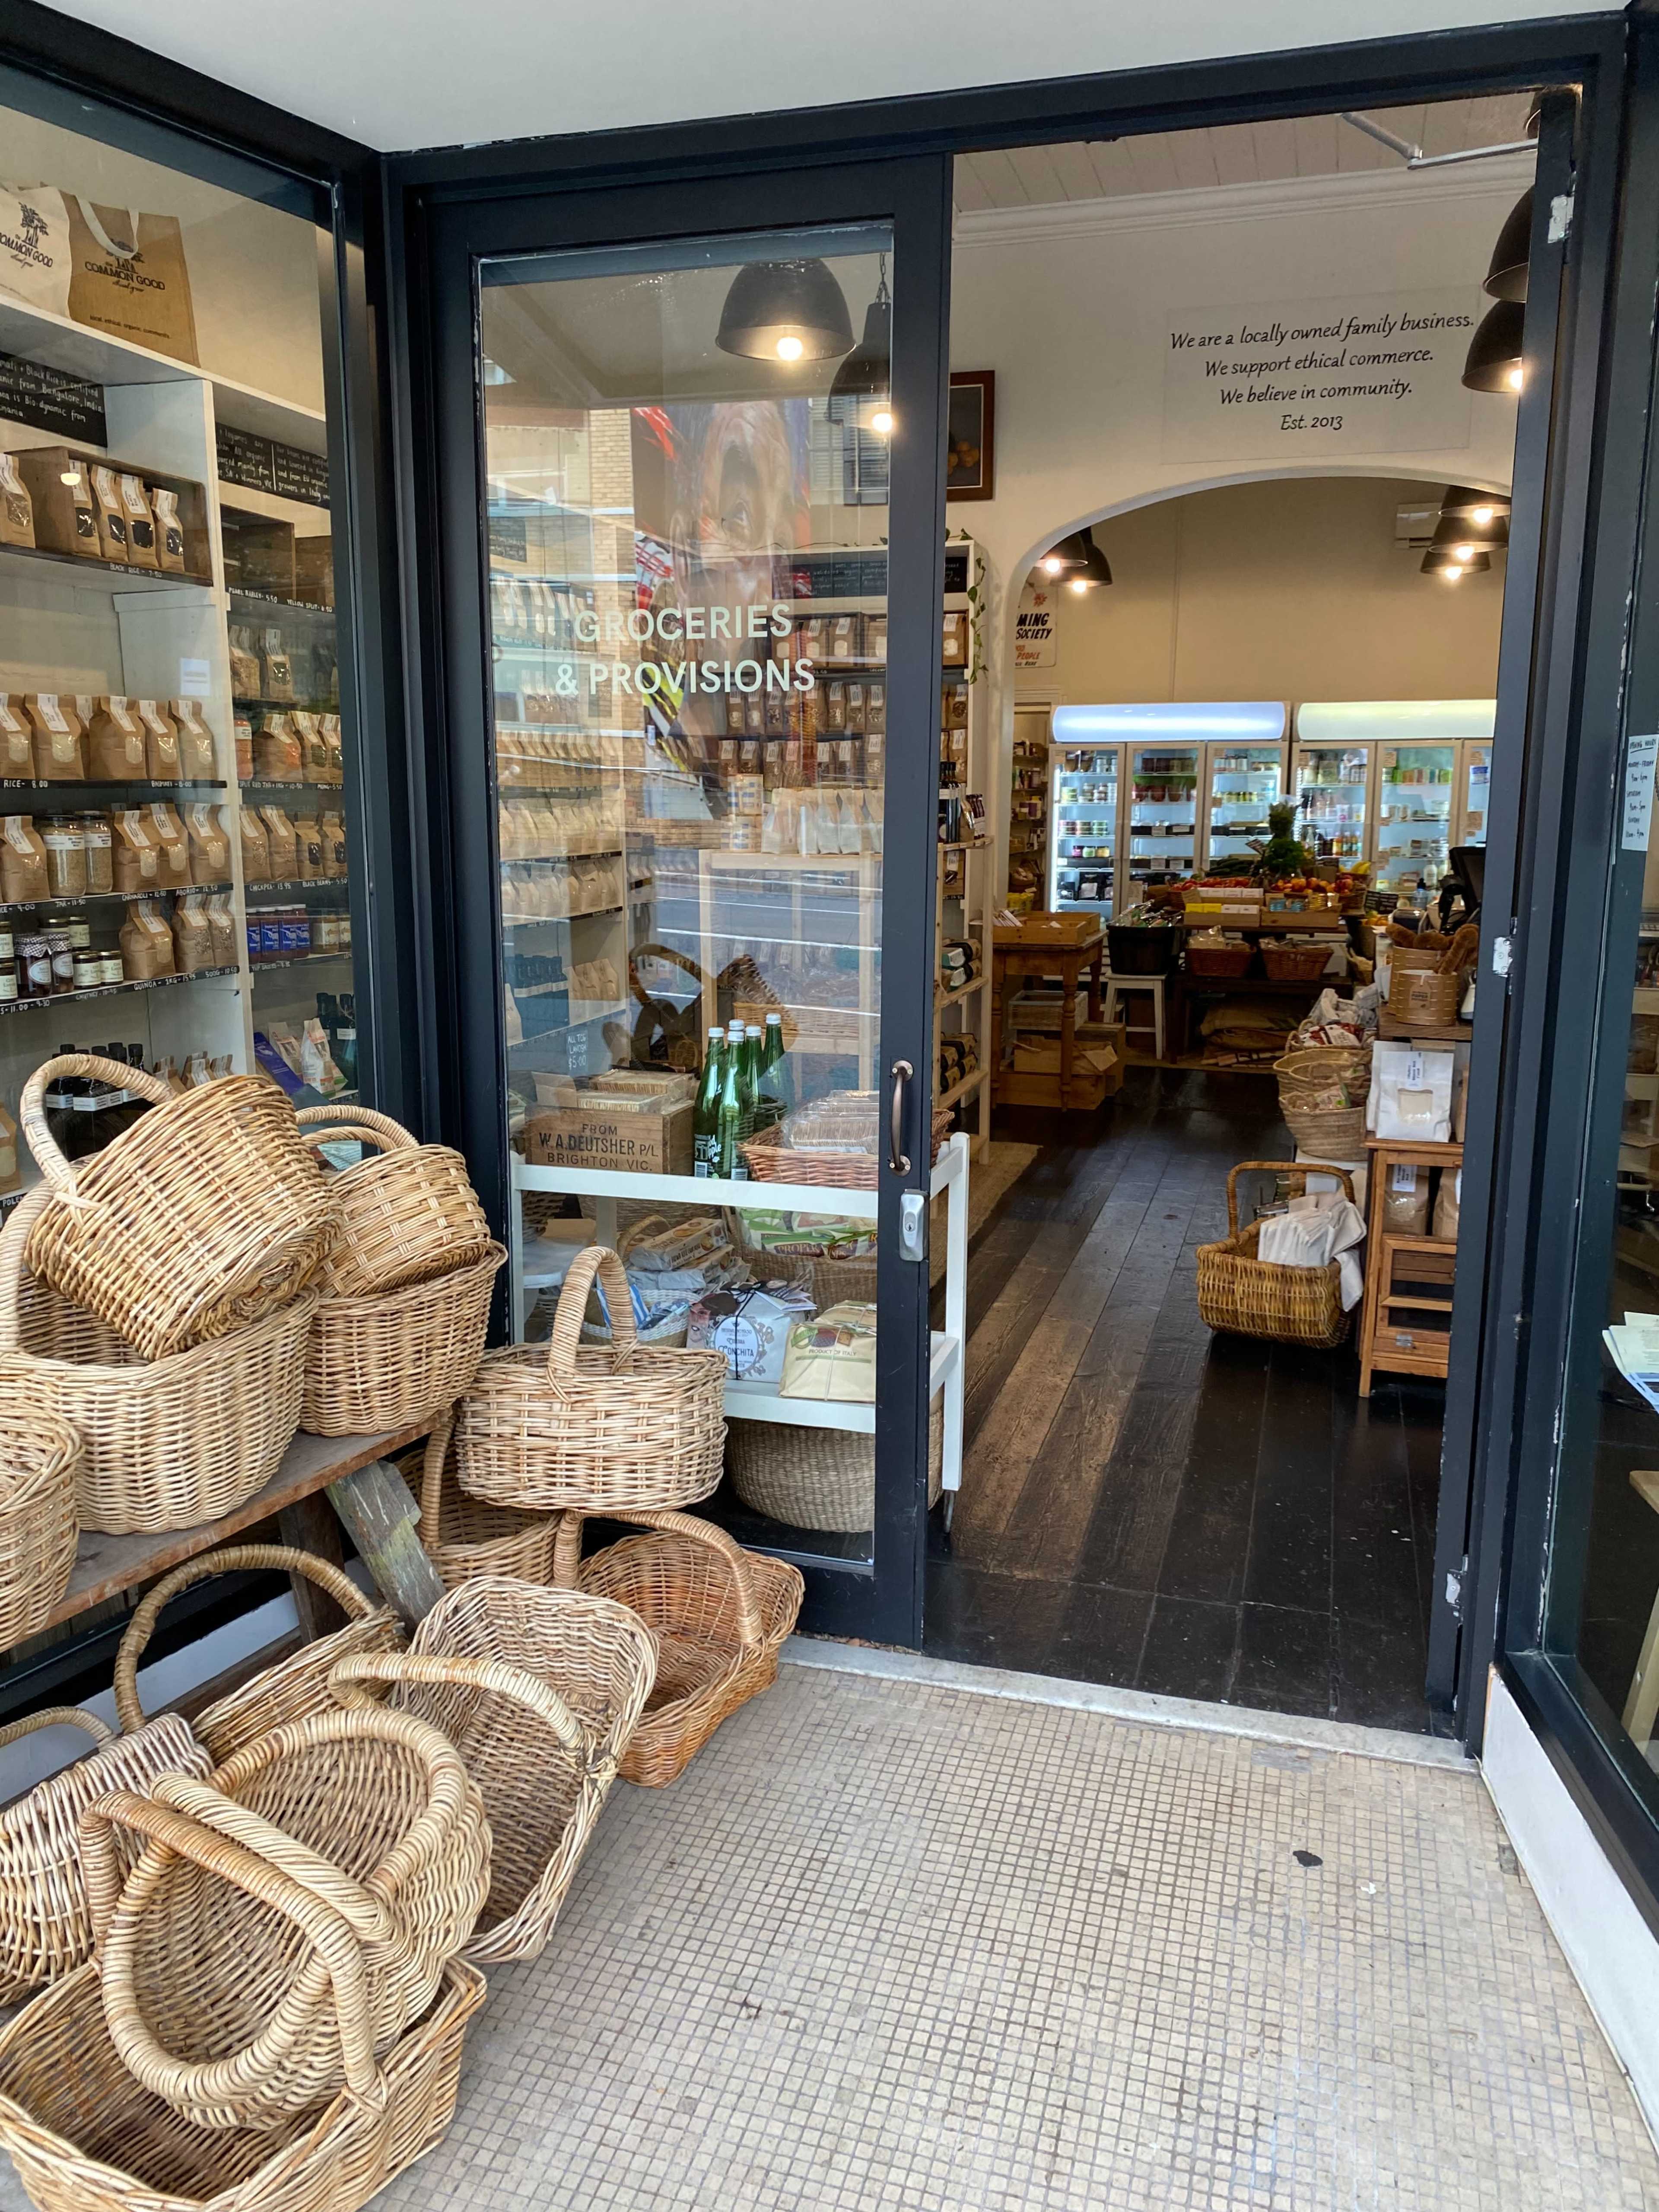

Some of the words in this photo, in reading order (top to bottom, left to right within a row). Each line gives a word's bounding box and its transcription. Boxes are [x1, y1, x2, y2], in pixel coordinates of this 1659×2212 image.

[0, 232, 33, 257] OMMON
[32, 251, 53, 267] GOOD
[85, 261, 134, 282] COMMON
[136, 275, 165, 290] GOOD
[1171, 332, 1195, 349] We
[1198, 335, 1222, 346] are
[1225, 334, 1234, 345] a
[1240, 323, 1290, 347] locally
[1290, 318, 1344, 340] owned
[1339, 314, 1398, 342] family
[1399, 312, 1474, 331] business.
[1205, 360, 1228, 377] We
[1230, 356, 1291, 378] support
[1294, 348, 1347, 369] ethical
[1349, 350, 1433, 366] commerce.
[25, 364, 44, 379] Black
[19, 377, 36, 391] from
[1220, 388, 1243, 404] We
[1246, 384, 1297, 403] believe
[1300, 385, 1316, 399] in
[1319, 378, 1412, 400] community.
[70, 409, 86, 423] from
[1281, 414, 1308, 430] Est.
[1310, 416, 1343, 431] 2013
[258, 465, 270, 477] from
[110, 563, 125, 572] BLACK
[229, 587, 244, 596] PEARL
[286, 599, 304, 607] YELLOW
[574, 603, 792, 642] GROCERIES
[1016, 628, 1053, 640] SOCIETY
[555, 663, 579, 696] &
[589, 658, 815, 695] PROVISIONS
[205, 970, 220, 978] 500G
[133, 982, 157, 991] QUINOA
[567, 1035, 577, 1044] ALL
[582, 1123, 618, 1135] FROM
[639, 1144, 659, 1157] P/L
[547, 1152, 618, 1168] BRIGHTON
[626, 1159, 653, 1172] VIC.
